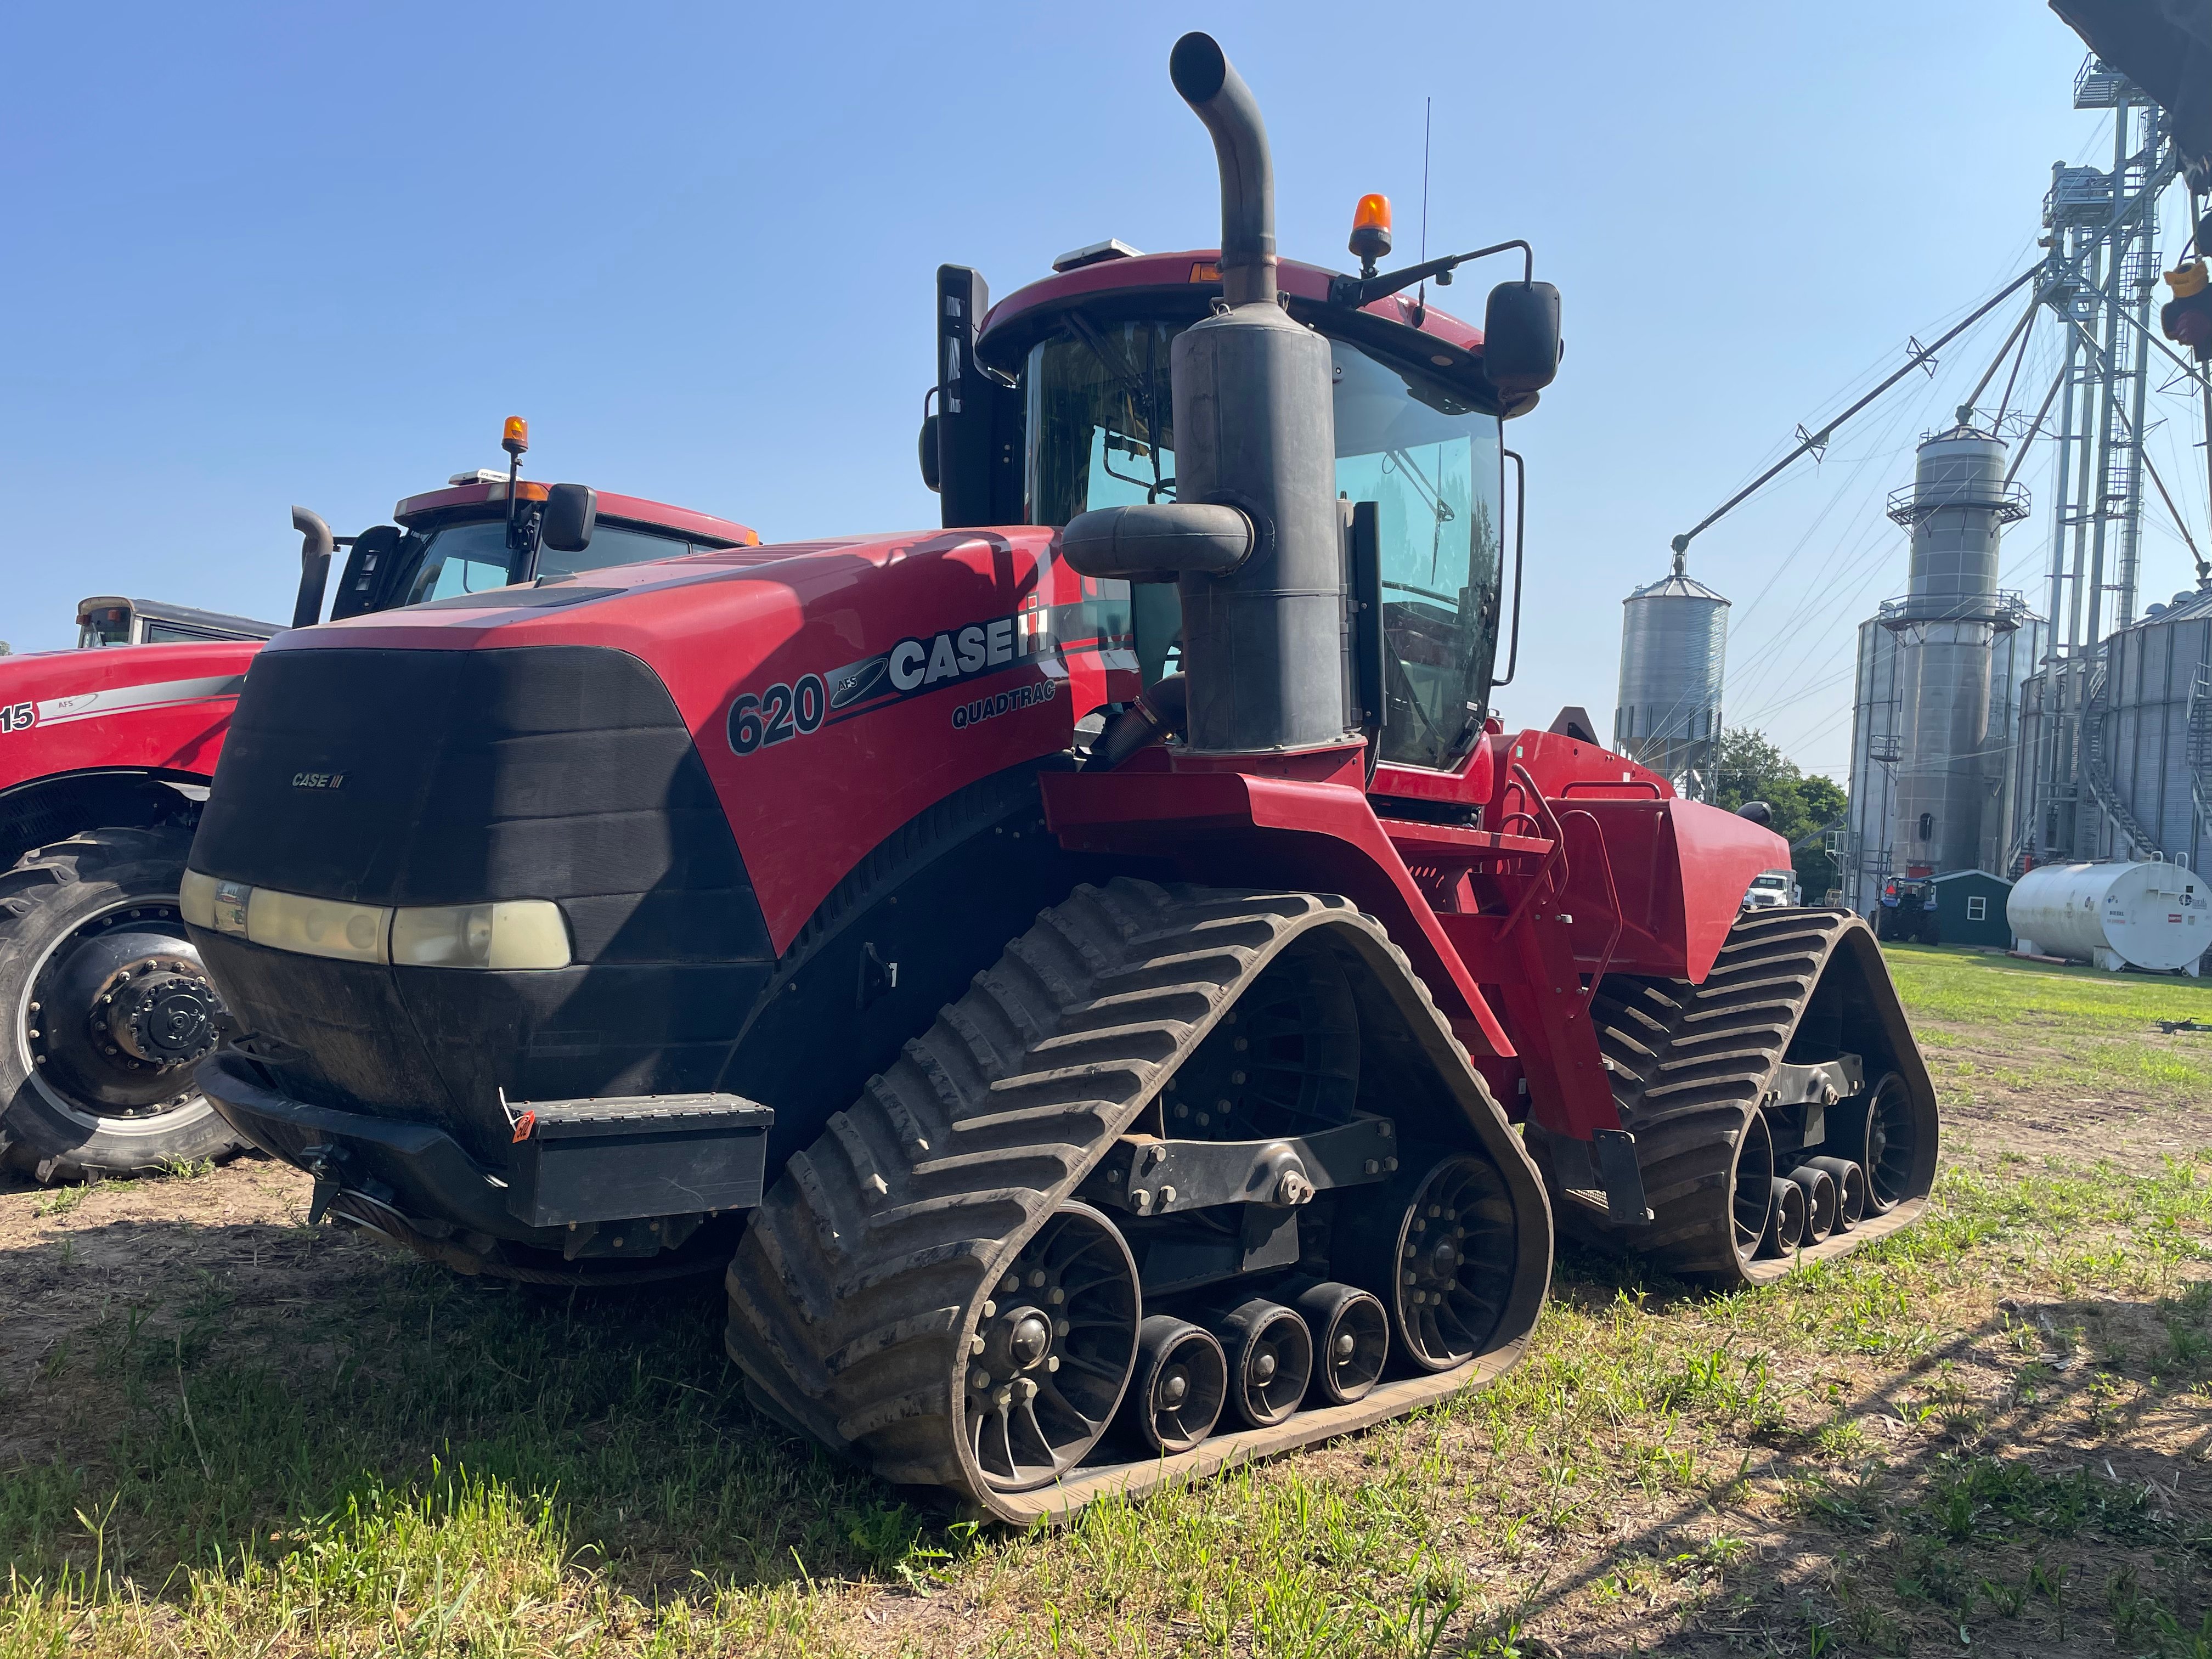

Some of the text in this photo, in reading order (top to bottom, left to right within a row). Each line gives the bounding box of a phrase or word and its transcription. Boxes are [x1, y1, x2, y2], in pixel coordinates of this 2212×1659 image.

[727, 673, 825, 756] 620
[838, 675, 857, 691] AFS
[889, 618, 1012, 690] CASE
[952, 679, 1056, 730] QUADTRAC
[292, 772, 329, 787] CASE
